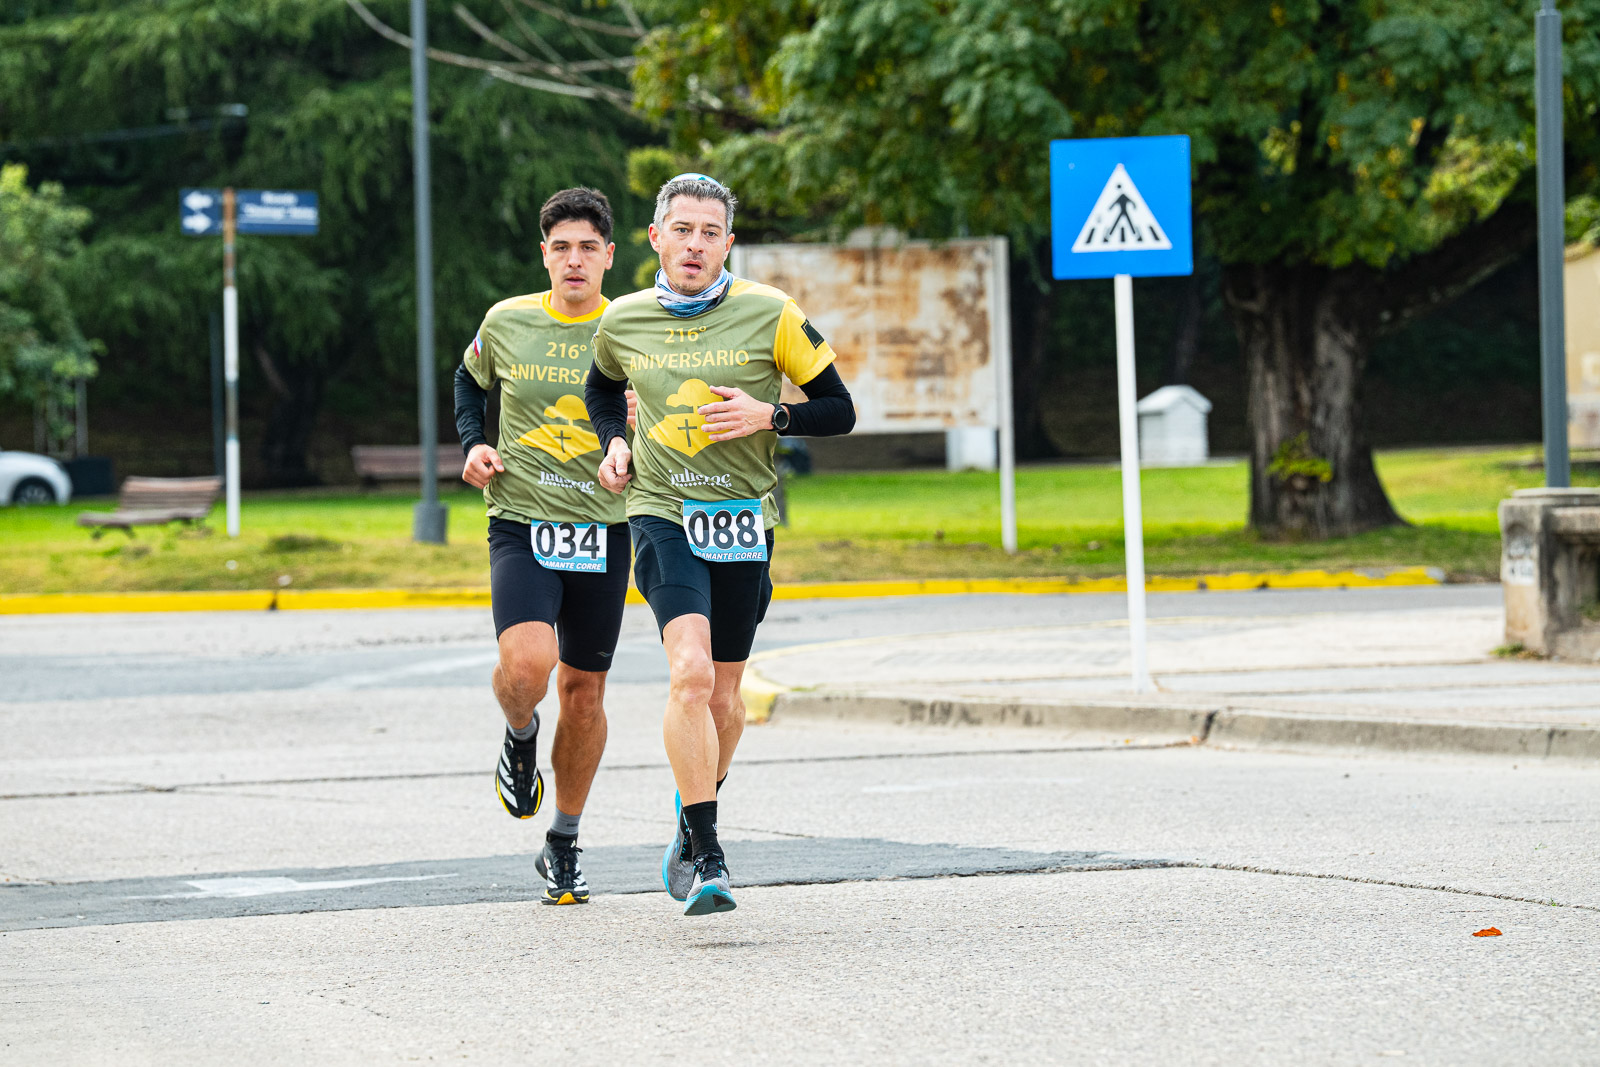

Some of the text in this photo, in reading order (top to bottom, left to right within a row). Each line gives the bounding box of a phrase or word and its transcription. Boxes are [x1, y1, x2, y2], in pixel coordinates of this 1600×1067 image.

[664, 325, 707, 344] 216°
[545, 341, 588, 360] 216°
[630, 349, 750, 373] ANIVERSARIO
[688, 508, 759, 550] 088
[535, 521, 600, 560] 034
[734, 551, 763, 560] CORRE
[576, 562, 603, 571] CORRE
